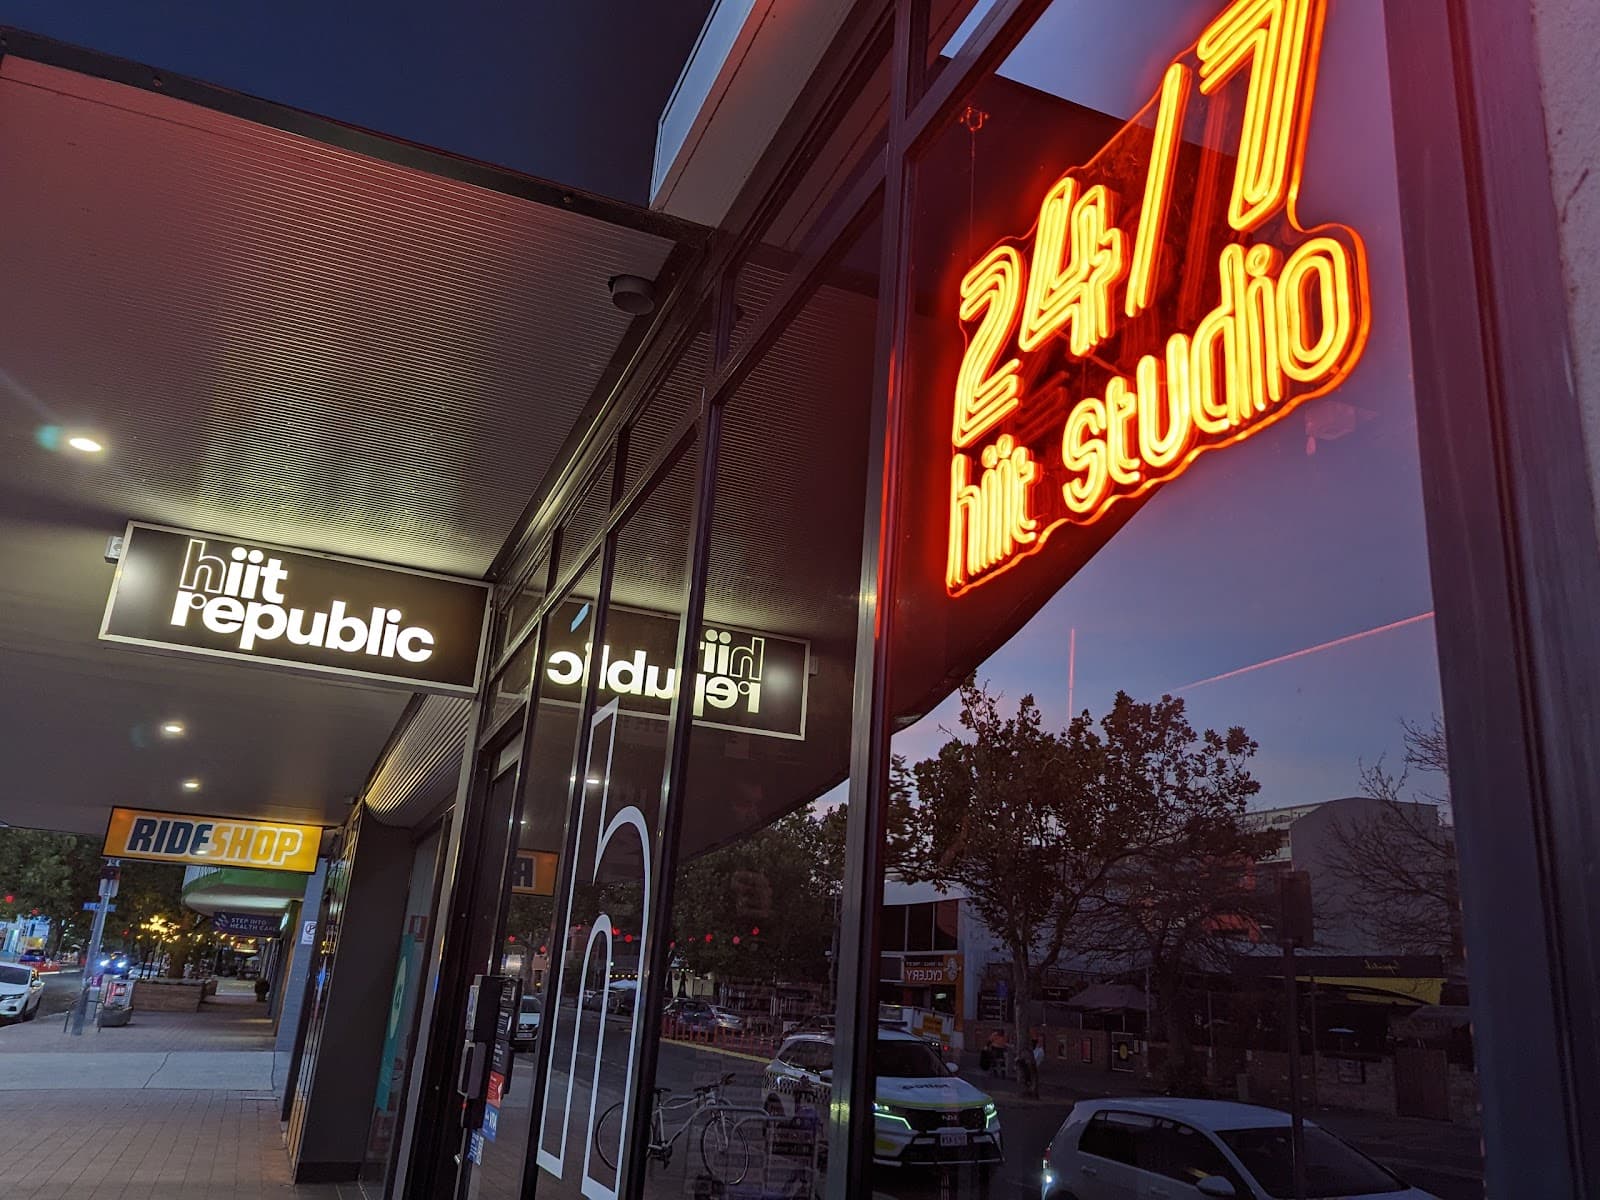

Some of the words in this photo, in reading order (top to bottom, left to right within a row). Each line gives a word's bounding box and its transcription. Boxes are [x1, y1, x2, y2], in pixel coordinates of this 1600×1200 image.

[956, 0, 1313, 448] 24/7
[945, 433, 1040, 588] hiit
[1062, 237, 1351, 514] studio
[179, 538, 288, 604] hiit
[170, 590, 435, 662] republic
[125, 815, 303, 866] RIDESHOP
